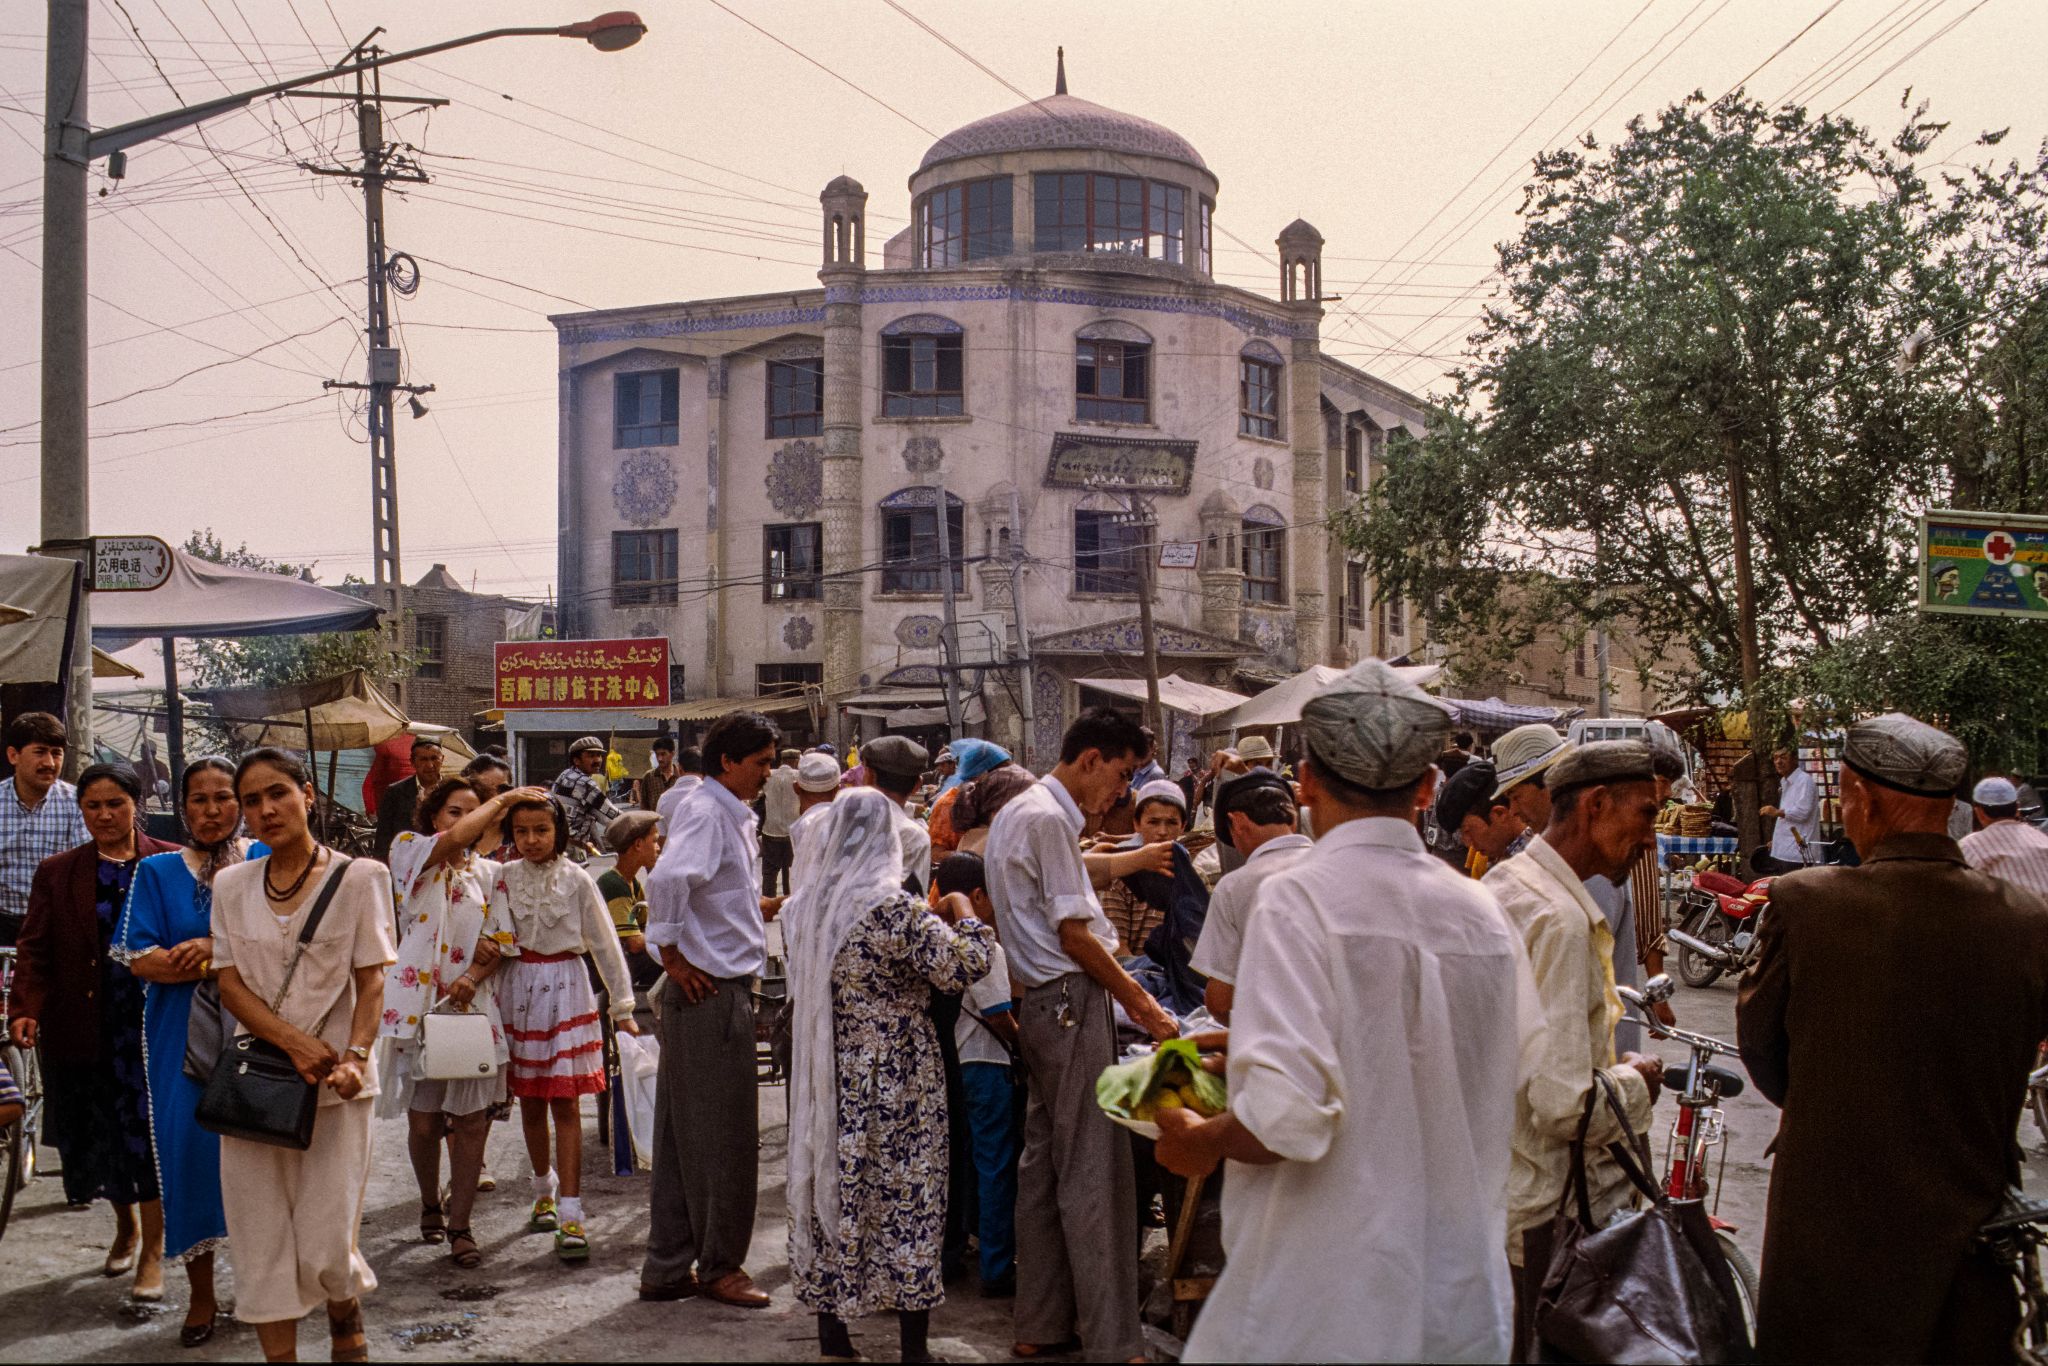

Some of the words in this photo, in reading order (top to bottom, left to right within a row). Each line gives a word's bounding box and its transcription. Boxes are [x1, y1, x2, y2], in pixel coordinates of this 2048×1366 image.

[97, 558, 141, 573] 公用电话
[97, 574, 123, 584] PUBLIC
